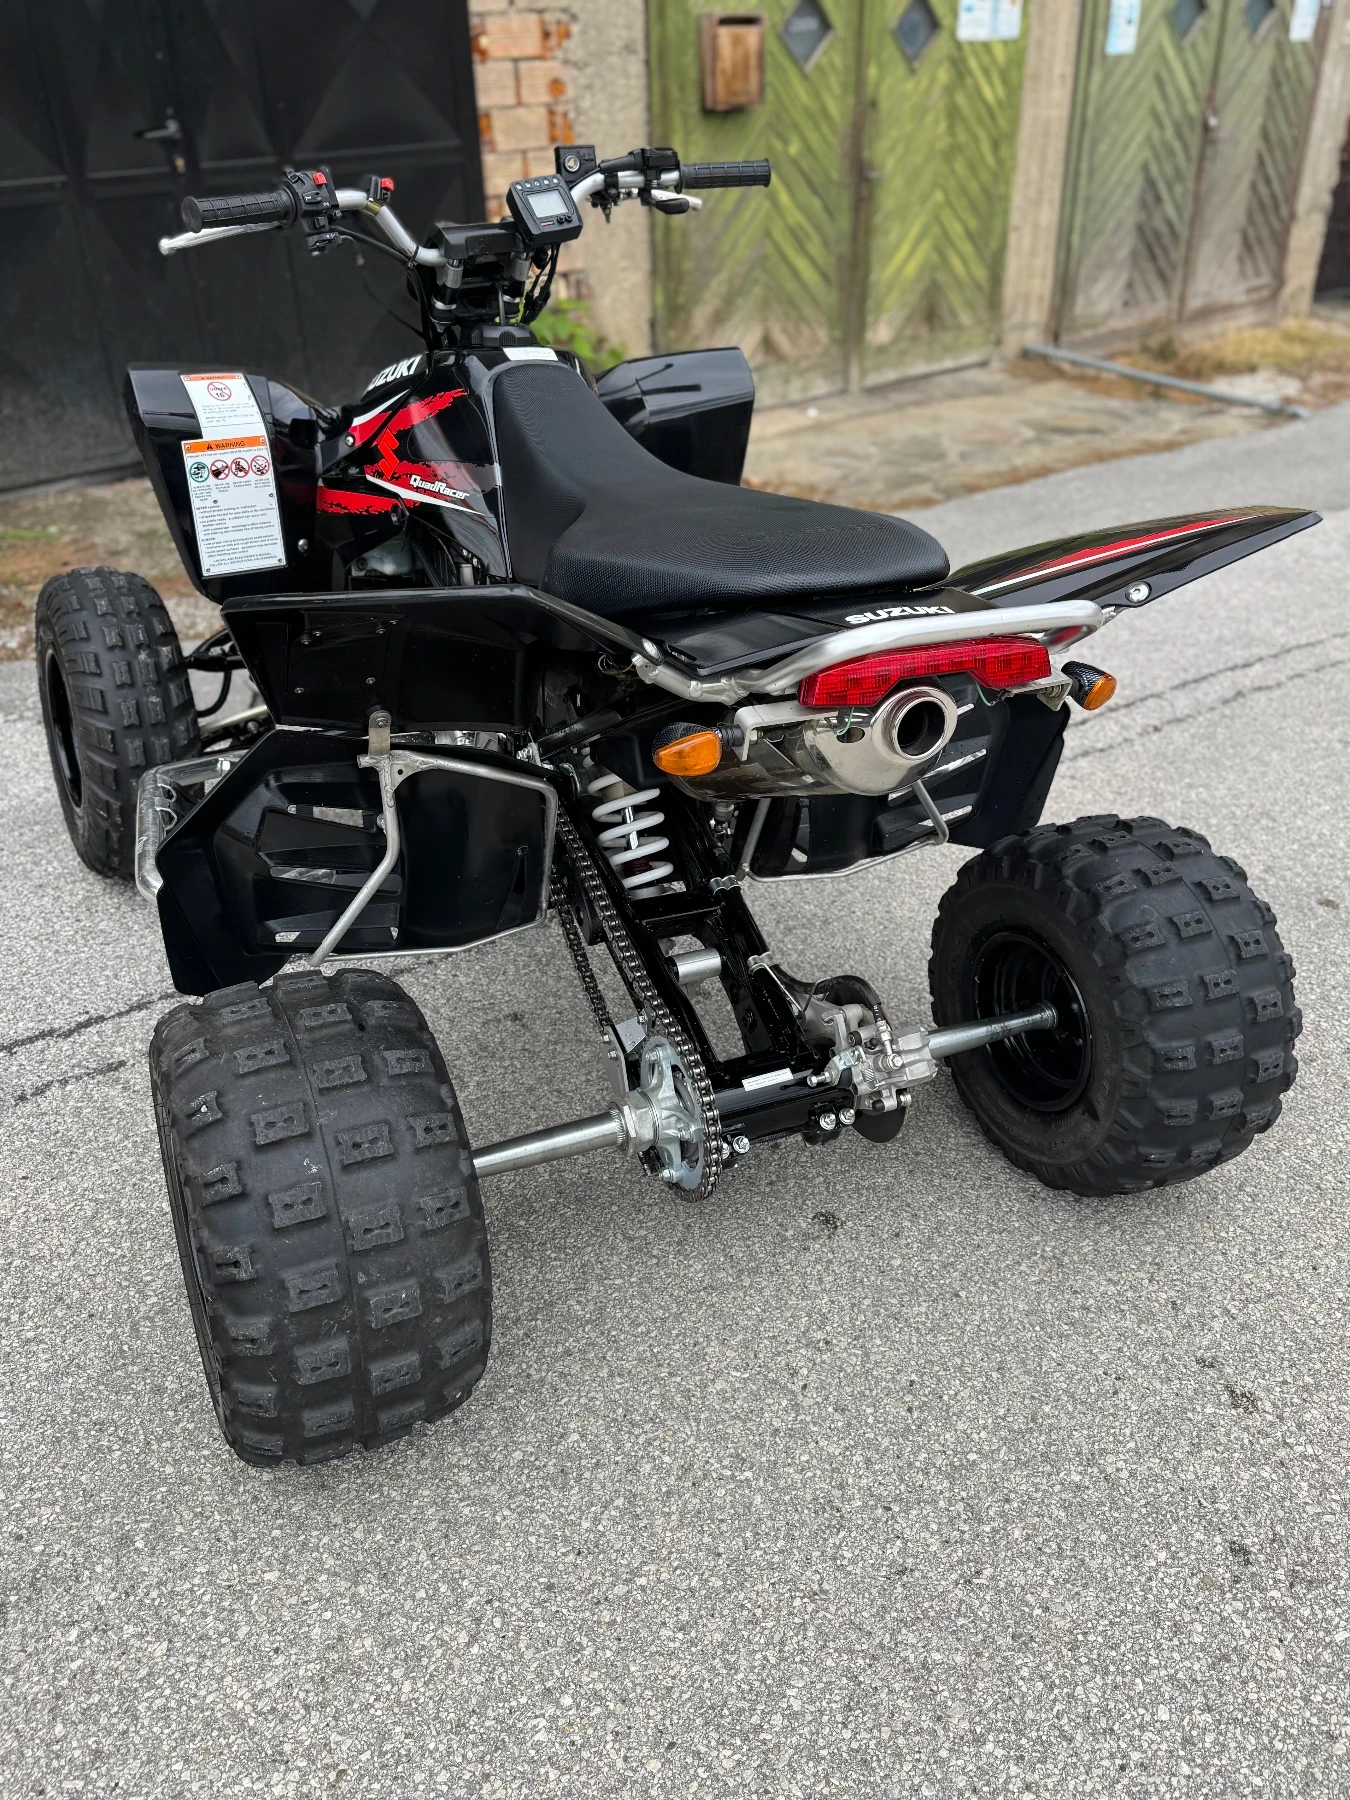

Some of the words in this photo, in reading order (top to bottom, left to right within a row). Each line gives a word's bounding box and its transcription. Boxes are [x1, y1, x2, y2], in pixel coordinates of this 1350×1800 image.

[366, 355, 422, 391] UZUKI
[215, 440, 246, 450] WARNING
[409, 475, 470, 500] QuadRacer
[844, 606, 956, 625] SUZUKI
